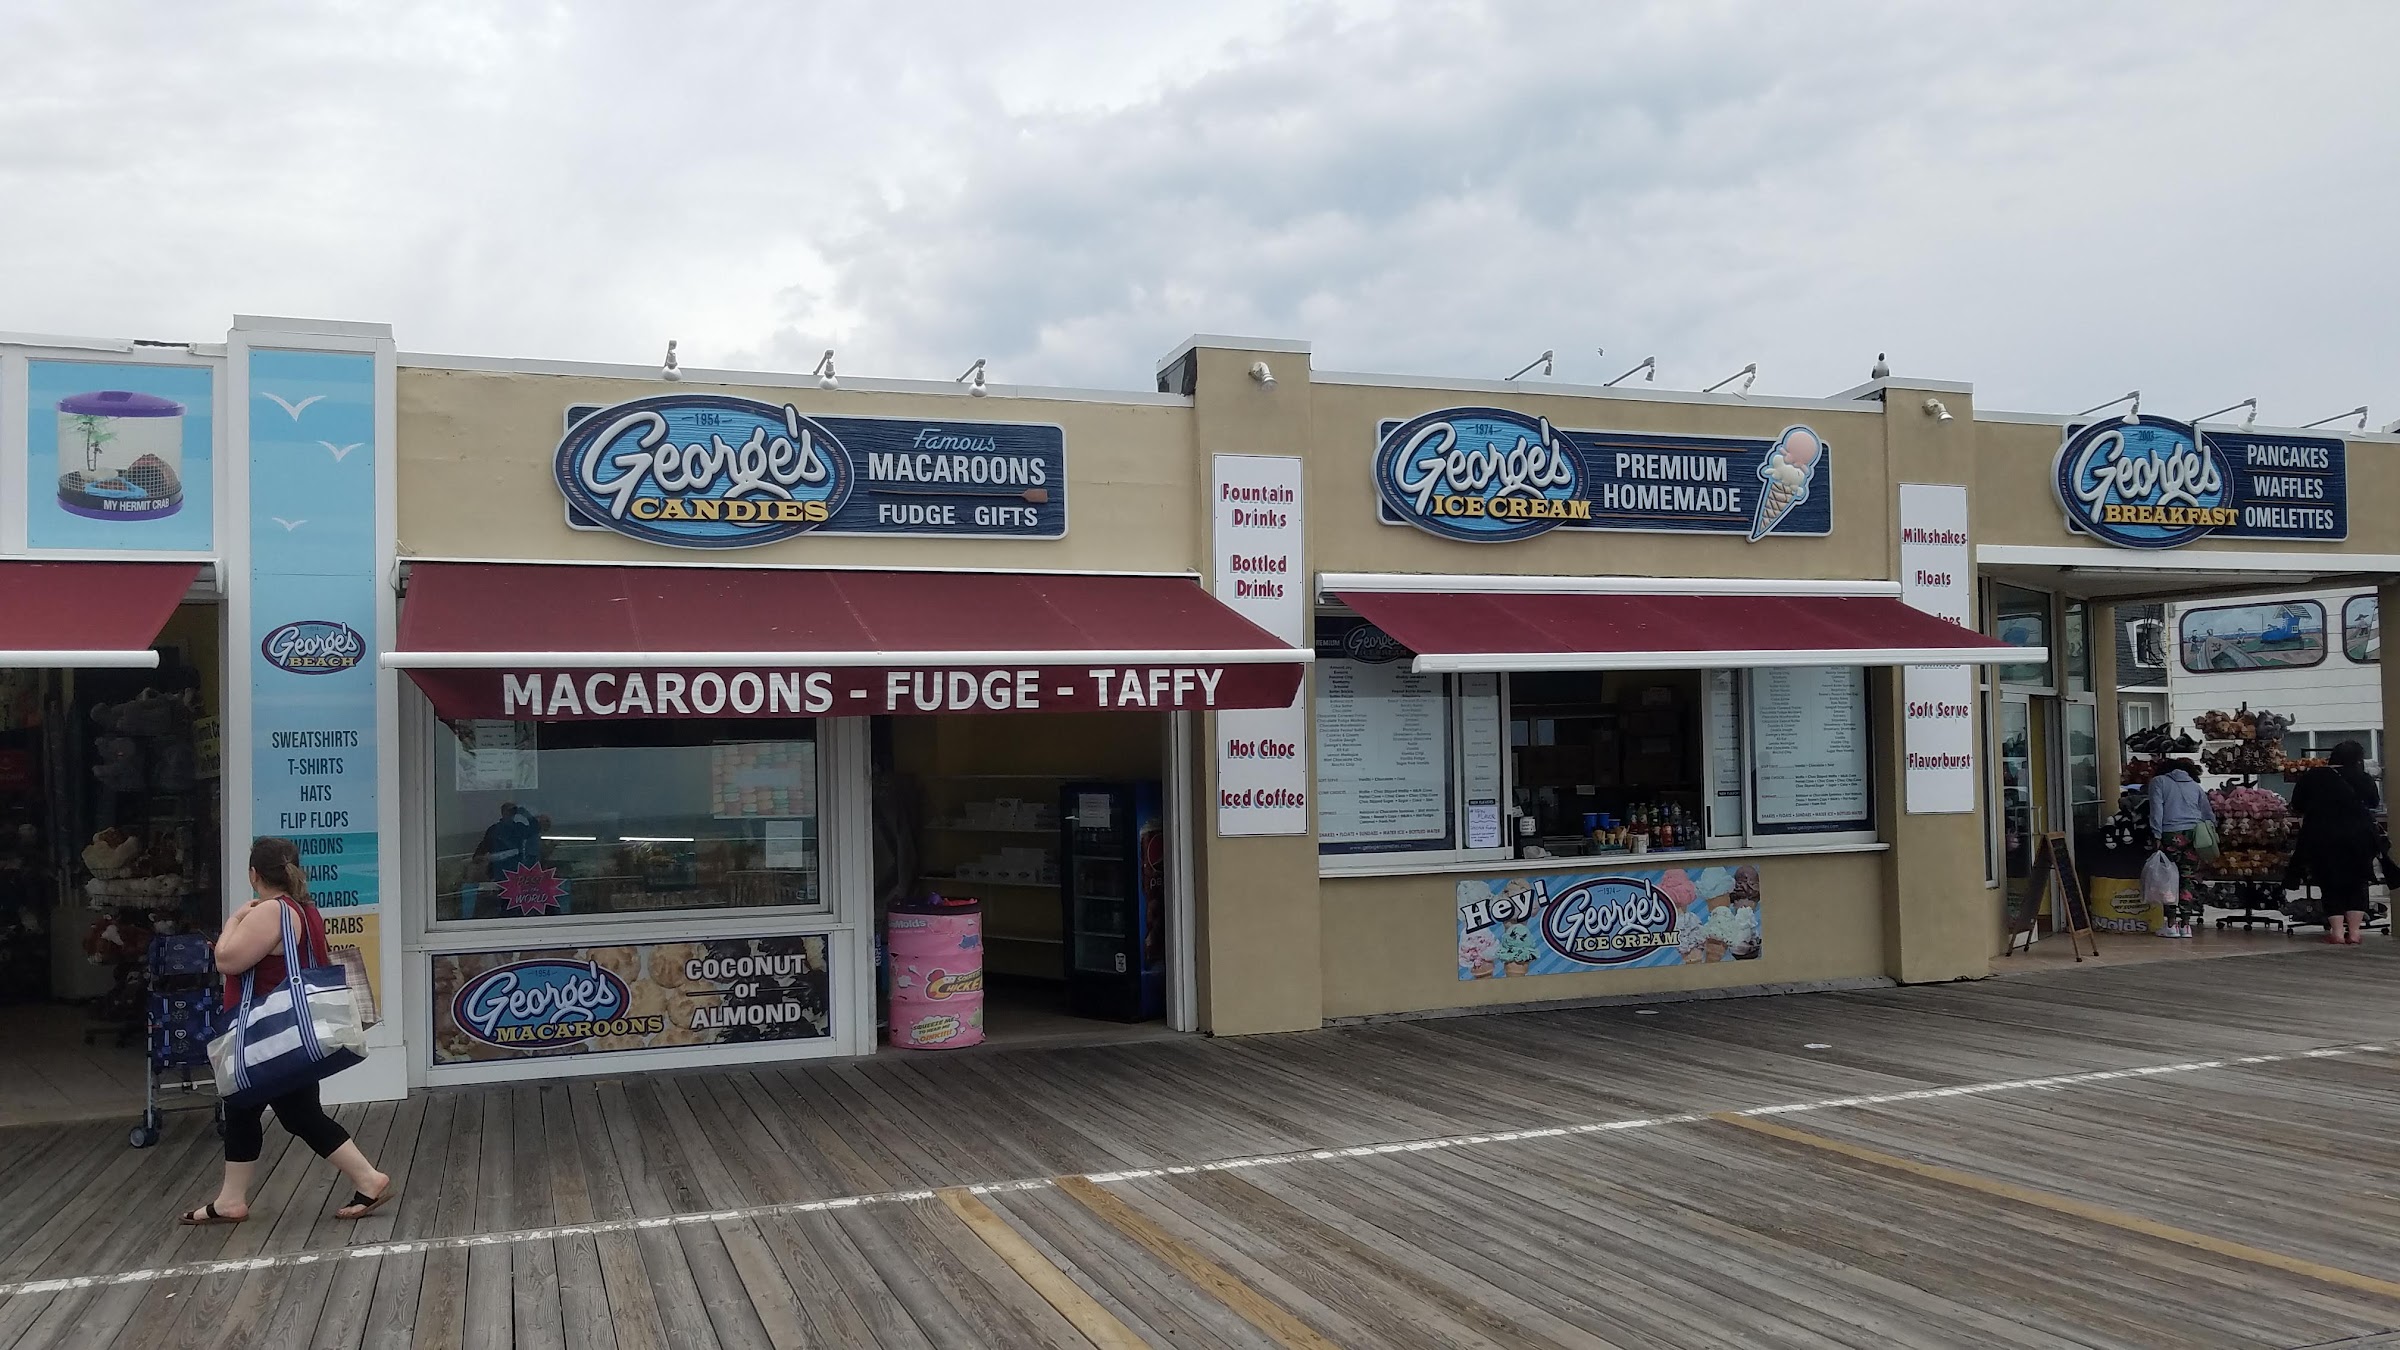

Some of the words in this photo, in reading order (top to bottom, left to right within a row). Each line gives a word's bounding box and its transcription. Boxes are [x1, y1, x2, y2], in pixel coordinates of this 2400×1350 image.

[694, 412, 720, 426] 1954
[913, 428, 997, 451] Famous
[581, 405, 826, 520] George's
[1395, 418, 1571, 515] George's
[2247, 444, 2329, 468] PANCAKES
[869, 452, 1047, 486] MACAROONS
[1616, 453, 1728, 482] PREMIUM
[2073, 423, 2221, 524] George's
[1222, 483, 1294, 503] Fountain
[2253, 476, 2324, 499] WAFFLES
[103, 500, 118, 510] MY
[120, 501, 151, 511] HERMIT
[152, 498, 170, 510] CRAB
[1433, 495, 1485, 516] ICE
[1488, 497, 1591, 519] CREAM
[1603, 484, 1742, 513] HOMEMADE
[631, 497, 830, 523] CANDIES
[879, 503, 956, 526] FUDGE
[974, 506, 1039, 528] GIFTS
[1233, 508, 1287, 527] Drinks
[2105, 505, 2239, 526] BREAKFAST
[2245, 507, 2334, 530] OMELETTES
[1903, 528, 1966, 545] Milkshakes
[1231, 554, 1287, 573] Bottled
[1236, 579, 1284, 598] Drinks
[1917, 570, 1951, 586] Floats
[269, 622, 357, 666] George's
[288, 657, 356, 667] BEACH
[502, 671, 834, 717] MACAROONS
[887, 669, 1040, 713] FUDGE
[1089, 667, 1225, 709] TAFFY
[1909, 702, 1933, 717] Soft
[1938, 702, 1968, 717] Serve
[272, 730, 358, 749] SWEATSHIRTS
[1230, 739, 1255, 757] Hot
[1260, 739, 1295, 758] Choc
[287, 757, 344, 775] T-SHIRTS
[1909, 753, 1970, 769] Flavorburst
[300, 785, 332, 802] HATS
[1221, 788, 1252, 807] Iced
[1256, 788, 1304, 807] Coffee
[280, 812, 307, 829] FLIP
[310, 811, 349, 828] FLOPS
[516, 893, 548, 903] WORLD
[1461, 879, 1549, 934] Hey!
[324, 917, 364, 934] CRABS
[1552, 878, 1666, 953] George's
[1576, 937, 1610, 951] ICE
[1611, 931, 1680, 948] CREAM
[685, 953, 807, 982] COCONUT
[466, 960, 616, 1037] George's
[734, 982, 760, 998] or
[689, 1002, 802, 1030] ALMOND
[495, 1015, 664, 1043] MACAROONS
